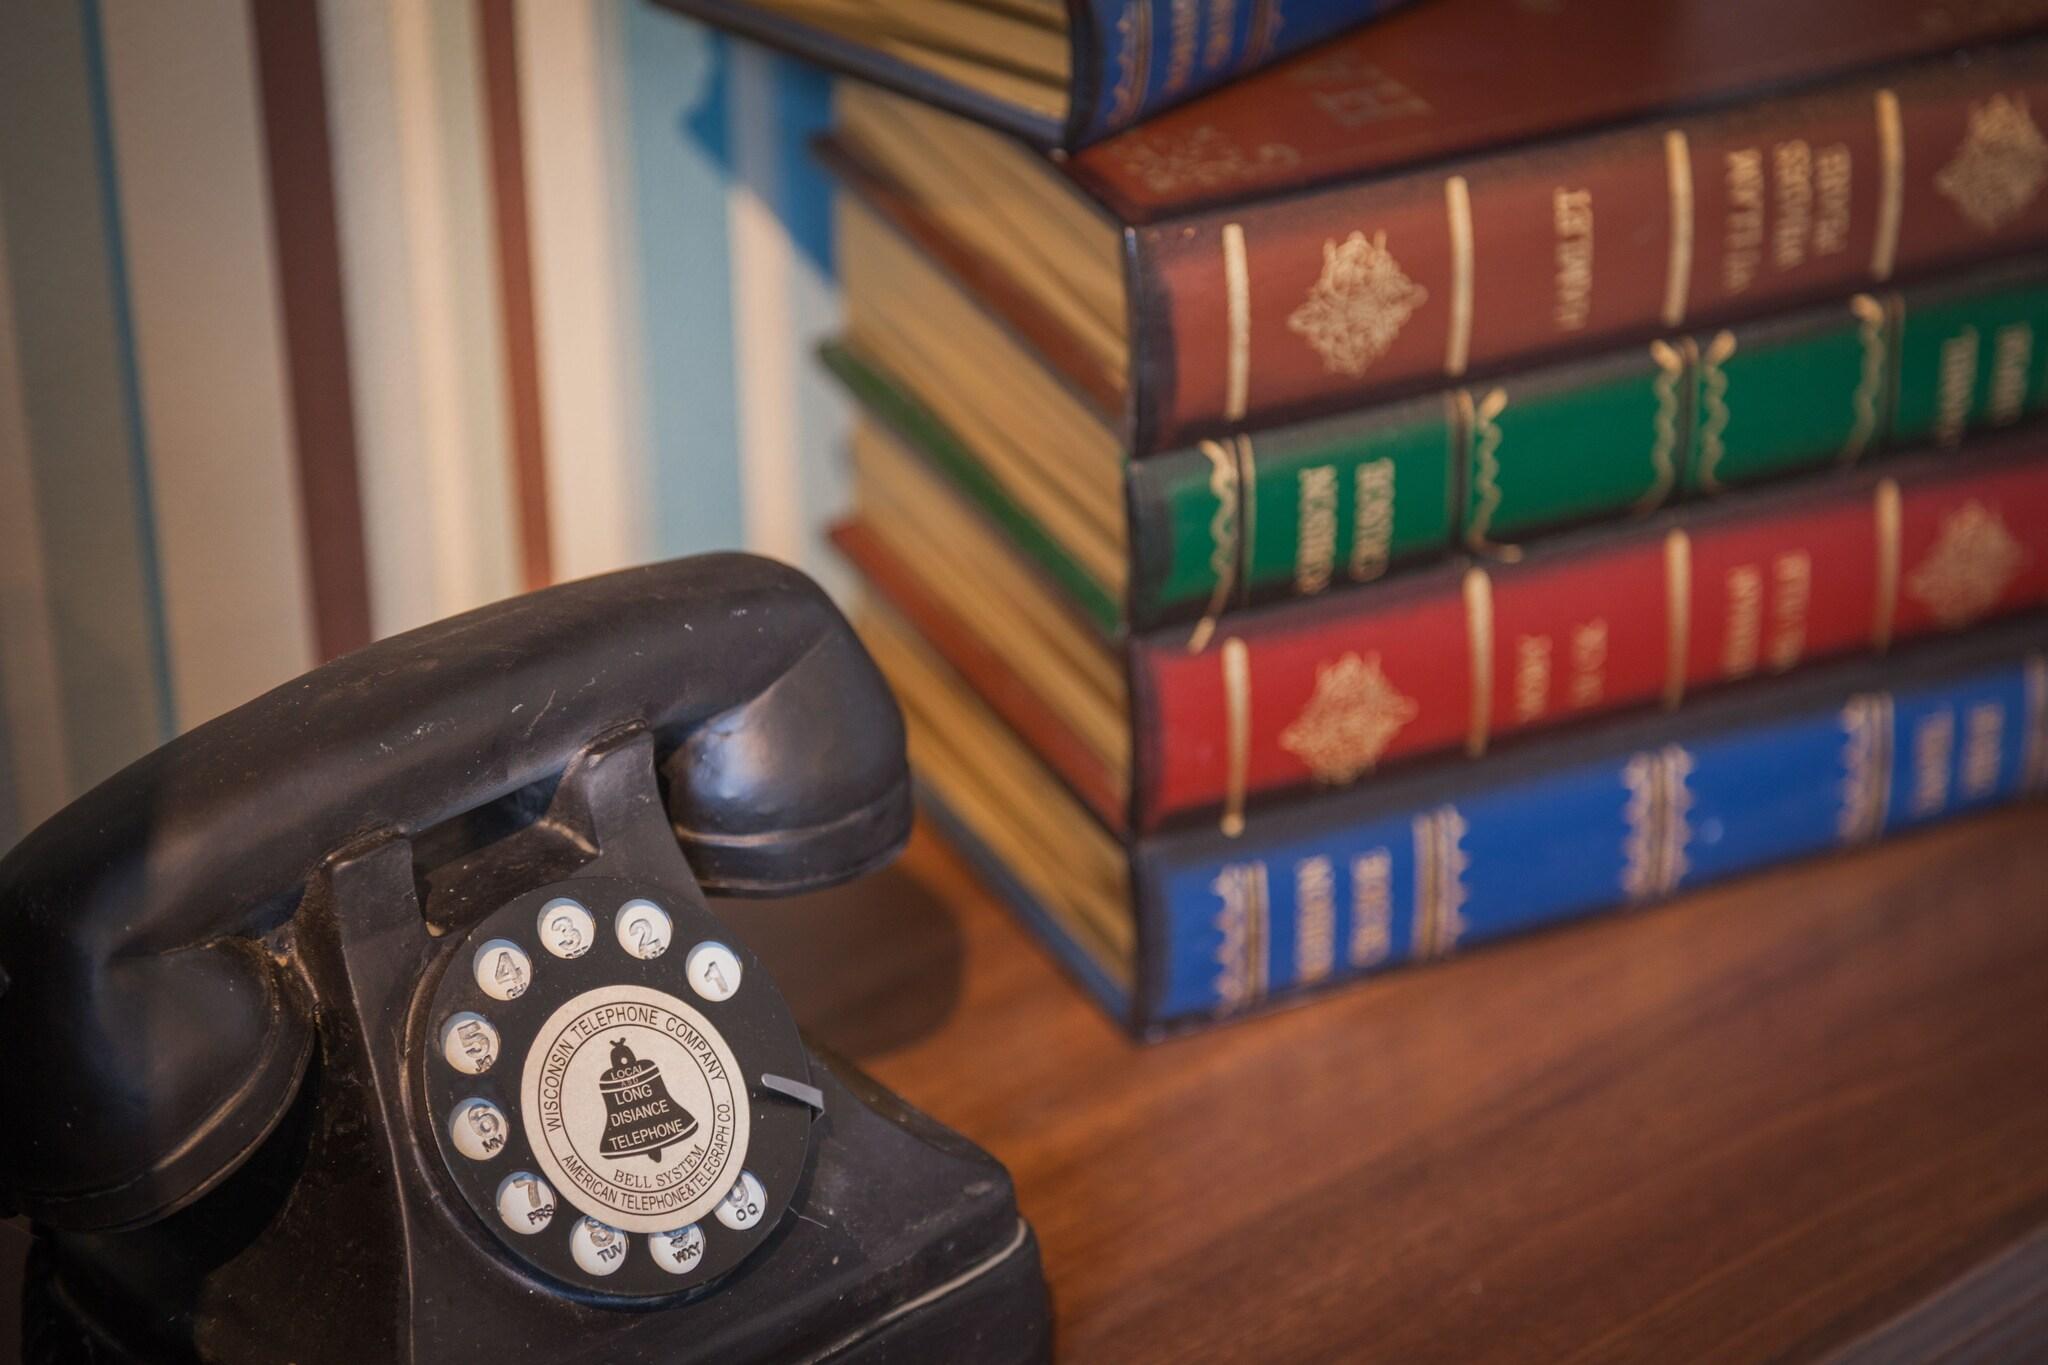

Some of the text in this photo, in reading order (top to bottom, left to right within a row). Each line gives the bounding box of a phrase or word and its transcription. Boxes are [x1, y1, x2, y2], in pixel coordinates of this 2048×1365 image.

[552, 916, 582, 950] 3
[629, 918, 660, 955] 2
[495, 952, 523, 985] 4
[704, 961, 728, 993] 1
[457, 1021, 490, 1058] 5
[543, 1006, 726, 1133] WISCONSIN TELEPHONE COMPANY
[615, 1086, 652, 1106] LONG
[468, 1102, 499, 1137] 6
[609, 1119, 684, 1150] TELEPHONE
[562, 1155, 618, 1205] AMERICAN
[716, 1100, 731, 1123] CO.
[613, 1144, 705, 1189] BELL SYSTEM
[512, 1173, 542, 1209] 7
[596, 1241, 624, 1263] TUV
[672, 1240, 702, 1264] WXY
